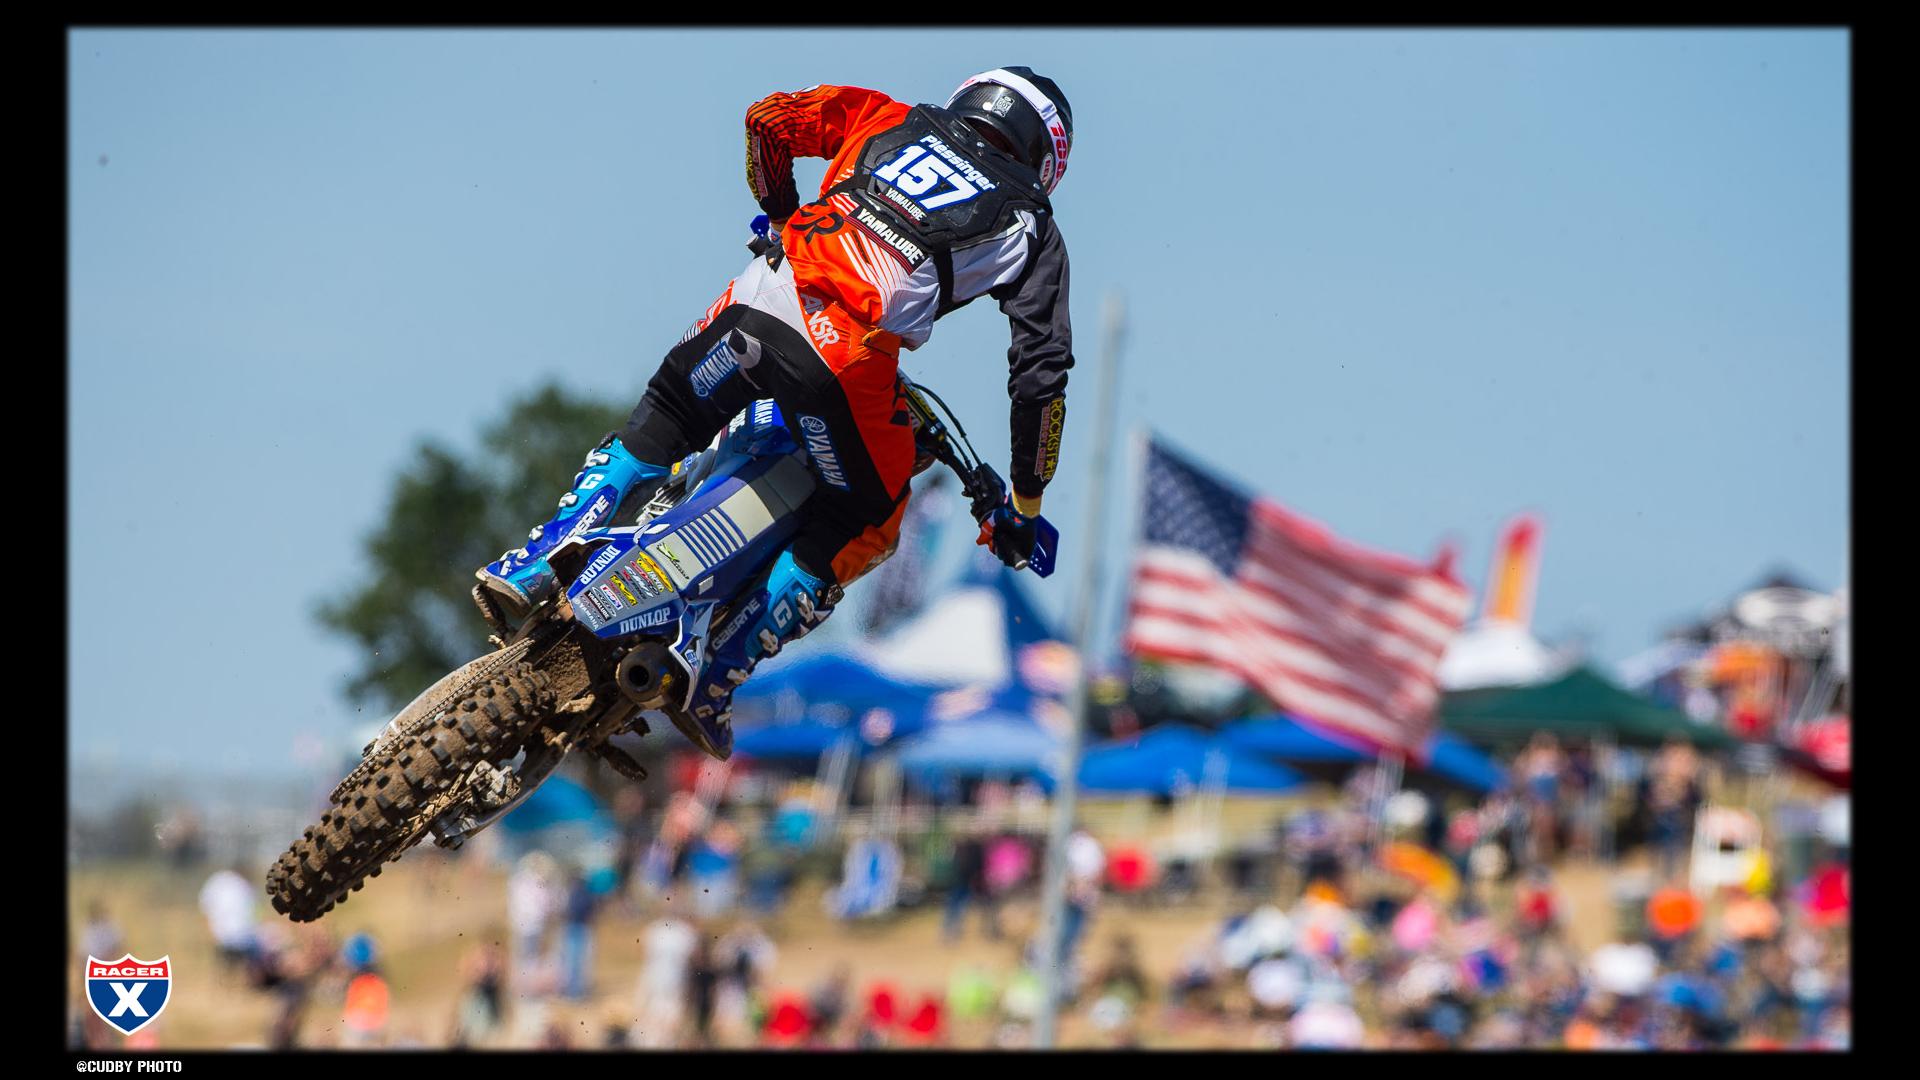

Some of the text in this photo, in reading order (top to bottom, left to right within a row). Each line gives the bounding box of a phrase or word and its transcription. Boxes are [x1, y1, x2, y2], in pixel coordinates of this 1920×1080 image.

[873, 144, 980, 210] 157
[919, 134, 996, 191] Plessinger
[885, 187, 927, 221] YAMALUBE
[857, 208, 925, 265] YAMALUBE
[699, 344, 738, 389] YAMAHA
[754, 398, 774, 433] AMAHA
[806, 434, 847, 487] YAMAHA
[580, 545, 621, 585] DUNLOP
[620, 606, 671, 634] DUNLOP
[711, 599, 761, 650] GAERNE
